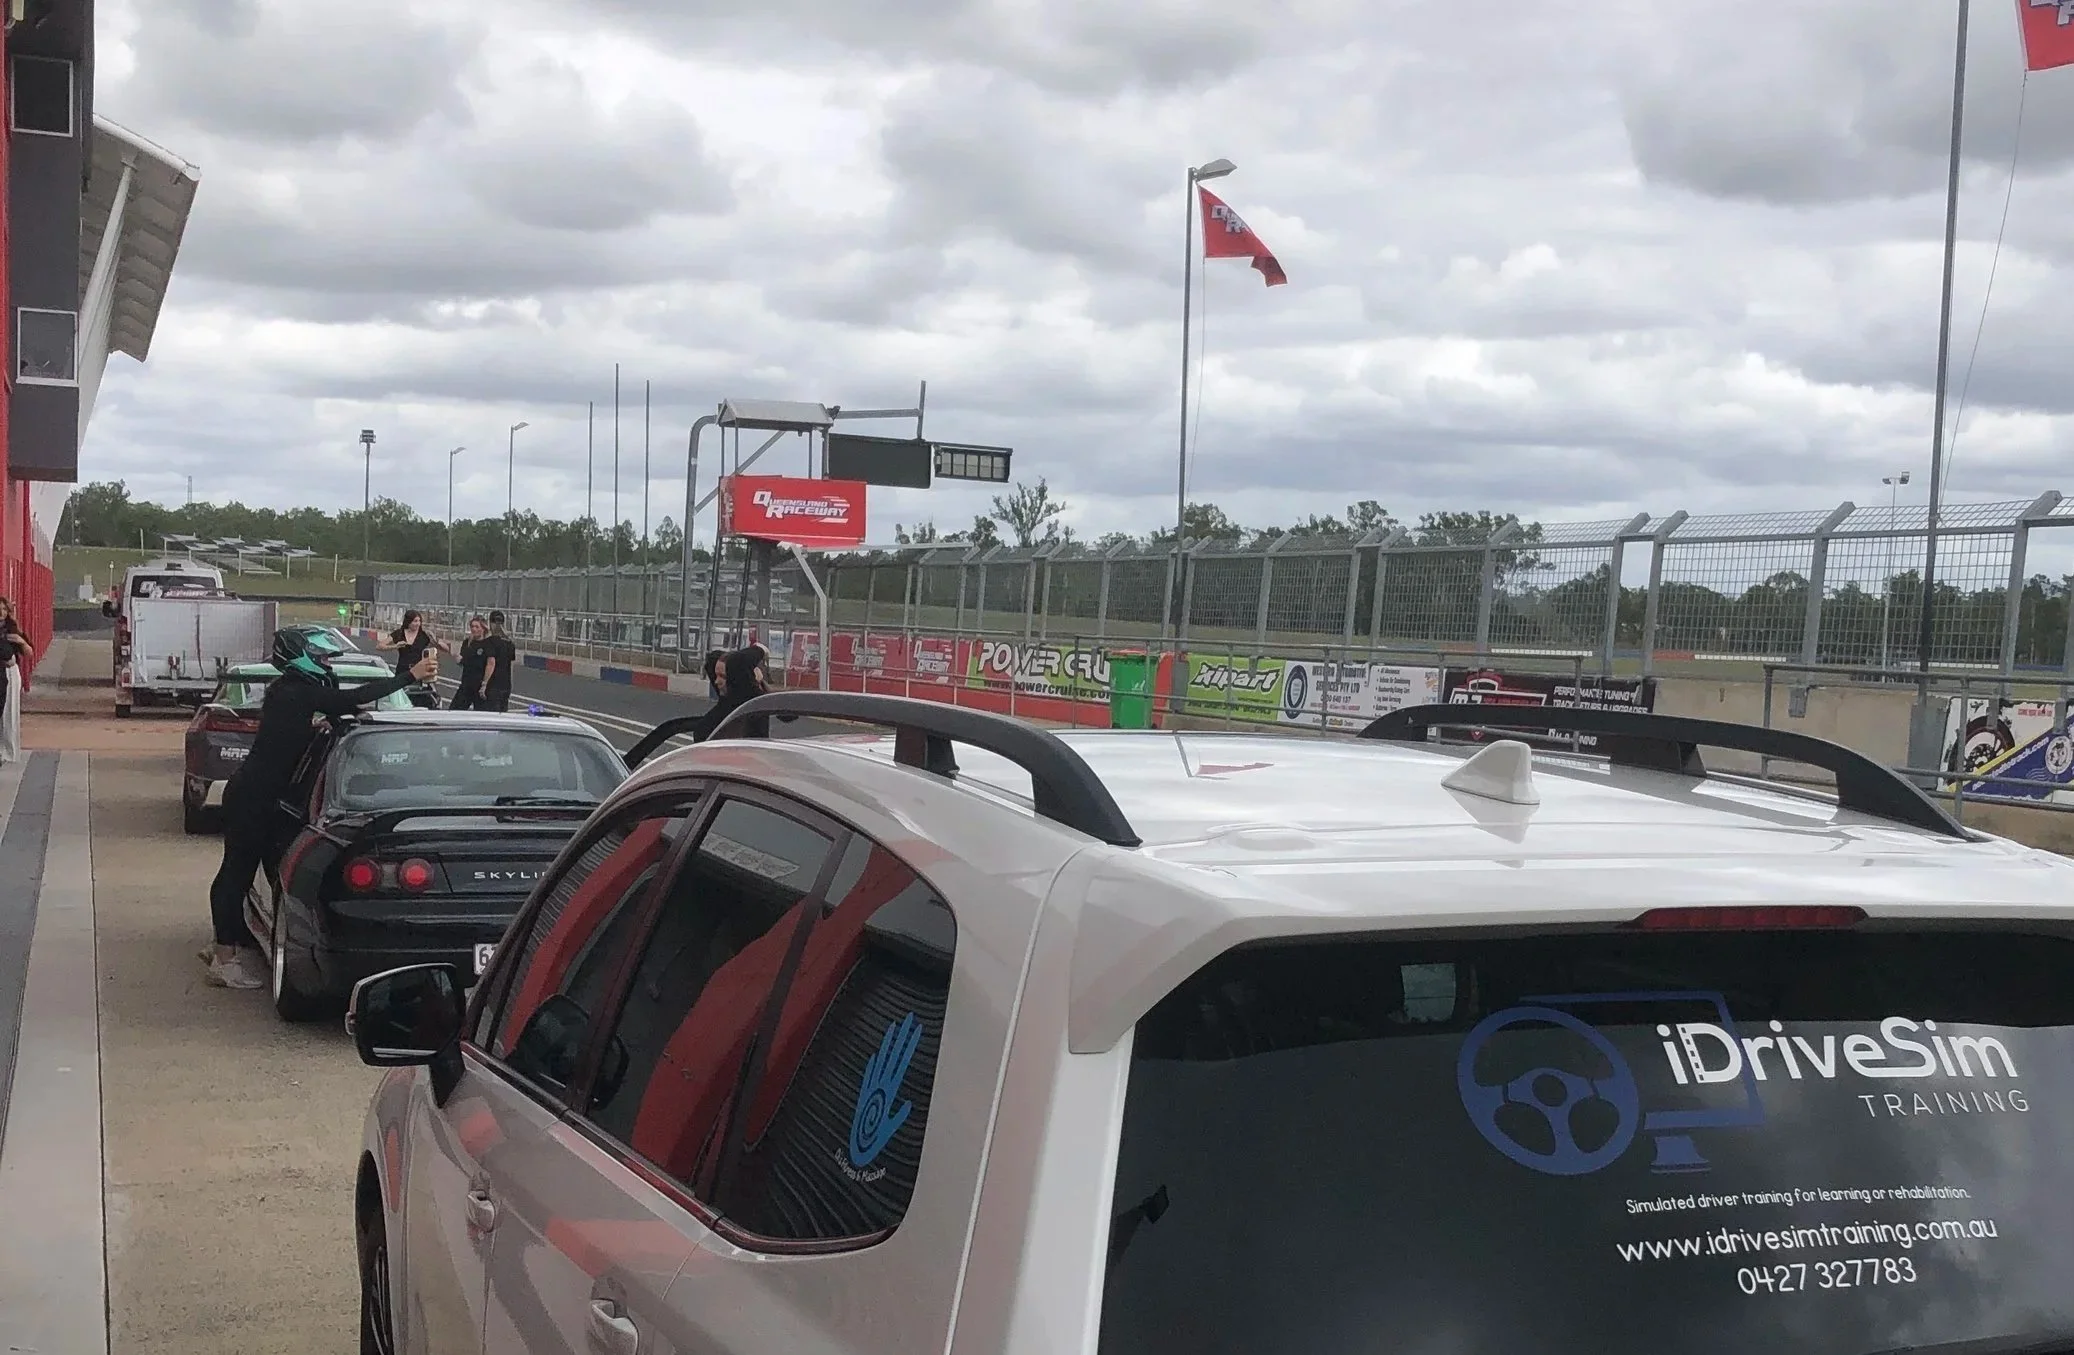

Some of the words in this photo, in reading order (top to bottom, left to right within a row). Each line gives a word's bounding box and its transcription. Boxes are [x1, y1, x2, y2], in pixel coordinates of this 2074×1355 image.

[765, 504, 847, 519] RACEWAY
[977, 642, 1061, 677] POWER
[1350, 682, 1360, 693] LTD
[1604, 690, 1630, 702] TUNING
[1656, 1016, 2019, 1084] iDriveSim
[1858, 1089, 2031, 1118] TRAINING
[1626, 1194, 1696, 1214] Simulated
[1697, 1193, 1739, 1208] driver
[1741, 1190, 1793, 1207] training
[1794, 1187, 1816, 1202] for
[1817, 1187, 1872, 1204] learning
[1872, 1189, 1886, 1199] or
[1888, 1185, 1971, 1200] rehabilitation.
[1615, 1217, 1999, 1262] www.idrivesimtraining.com.au
[1737, 1262, 1807, 1295] 0427
[1814, 1256, 1917, 1290] 327783
